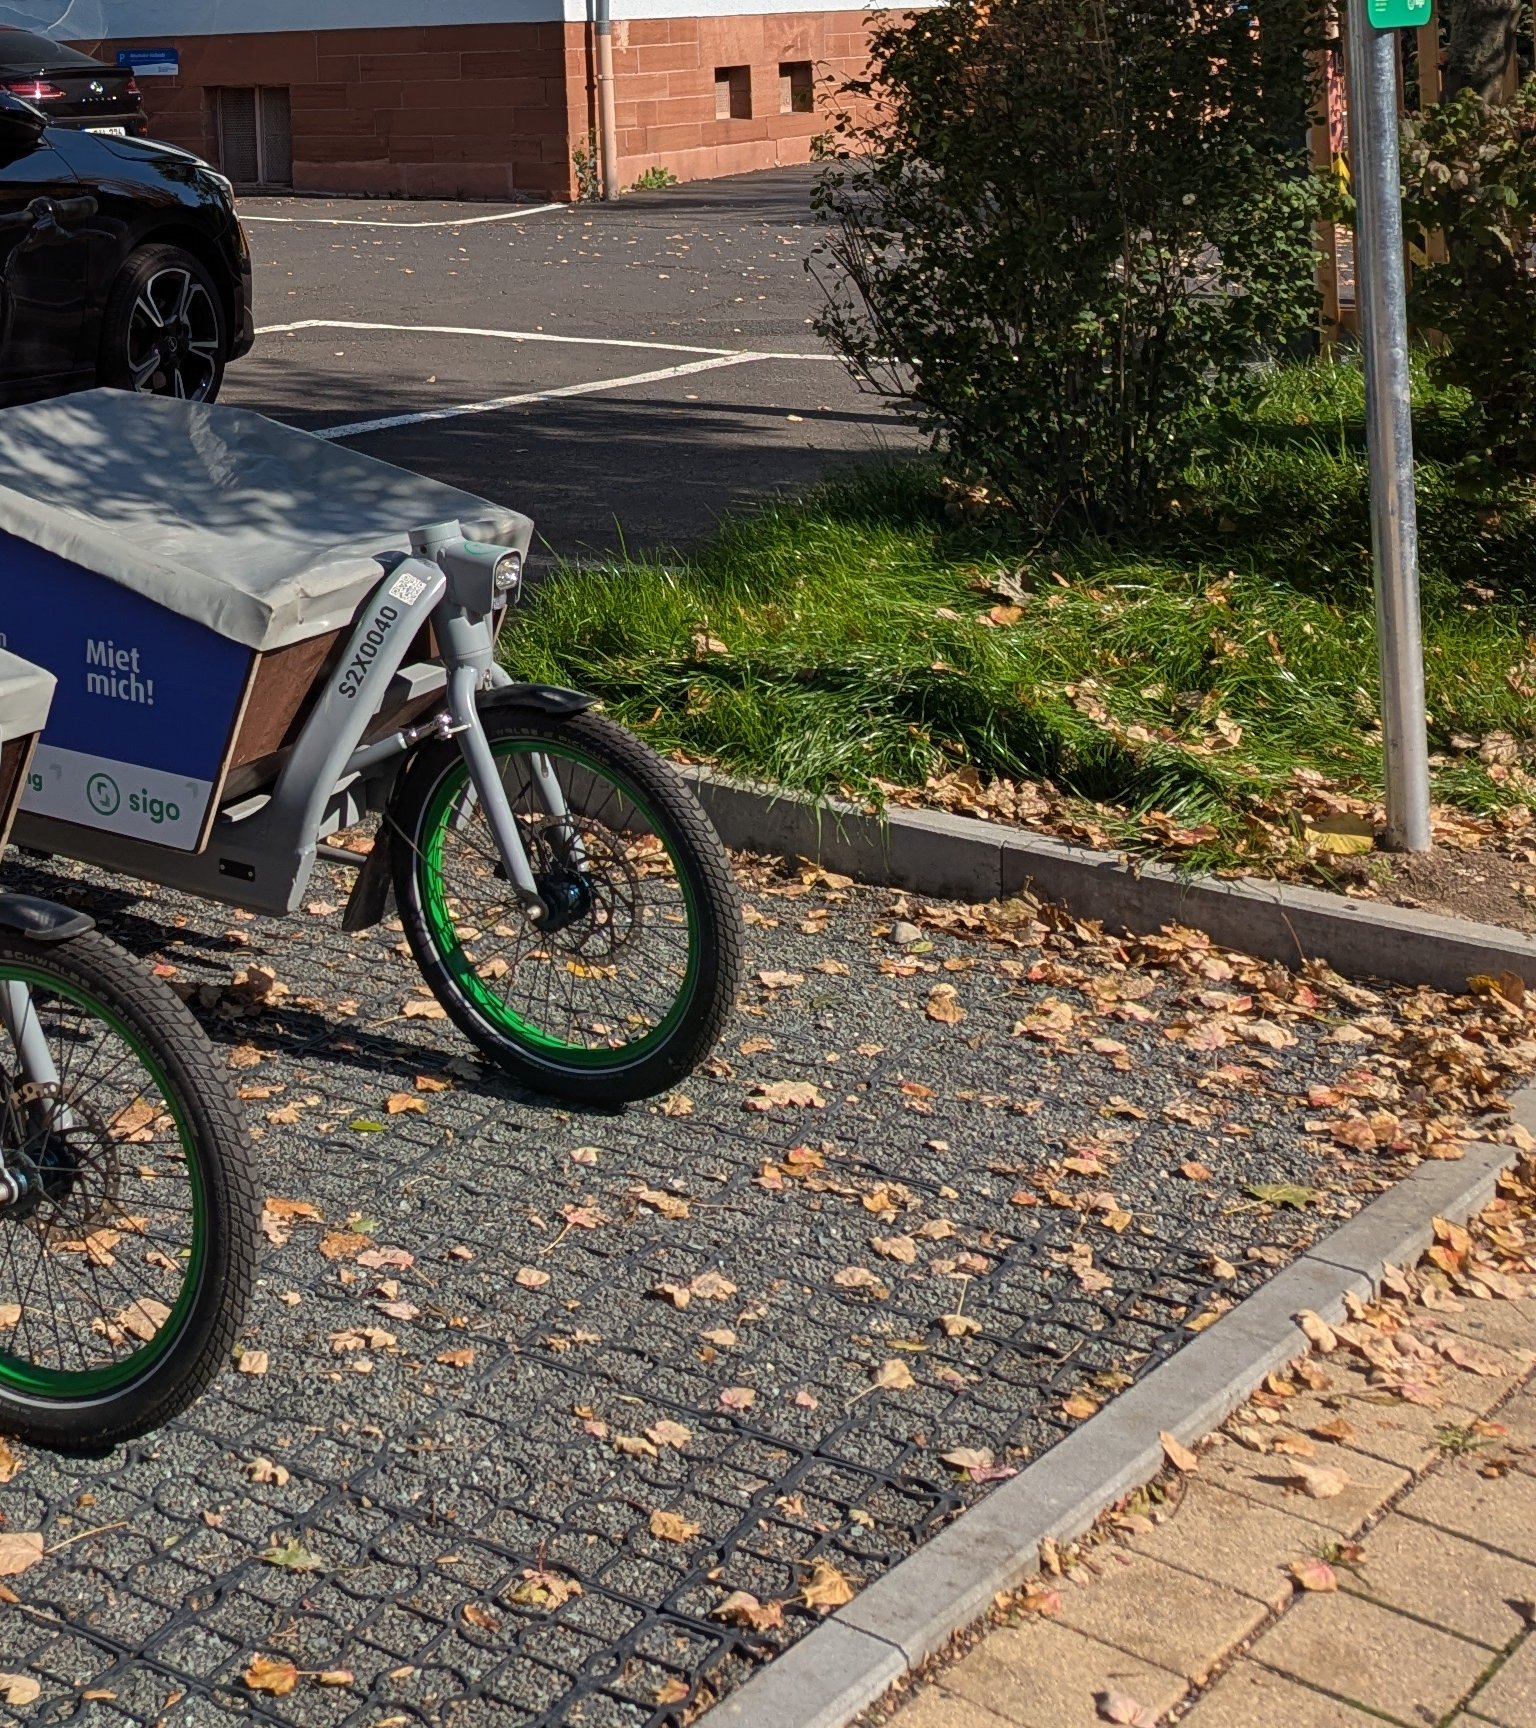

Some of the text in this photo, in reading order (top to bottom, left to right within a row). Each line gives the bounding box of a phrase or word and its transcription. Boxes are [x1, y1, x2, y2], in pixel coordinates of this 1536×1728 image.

[86, 638, 140, 674] Miet
[338, 605, 398, 699] S2X0040
[86, 669, 154, 706] mich!
[128, 788, 181, 824] sigo
